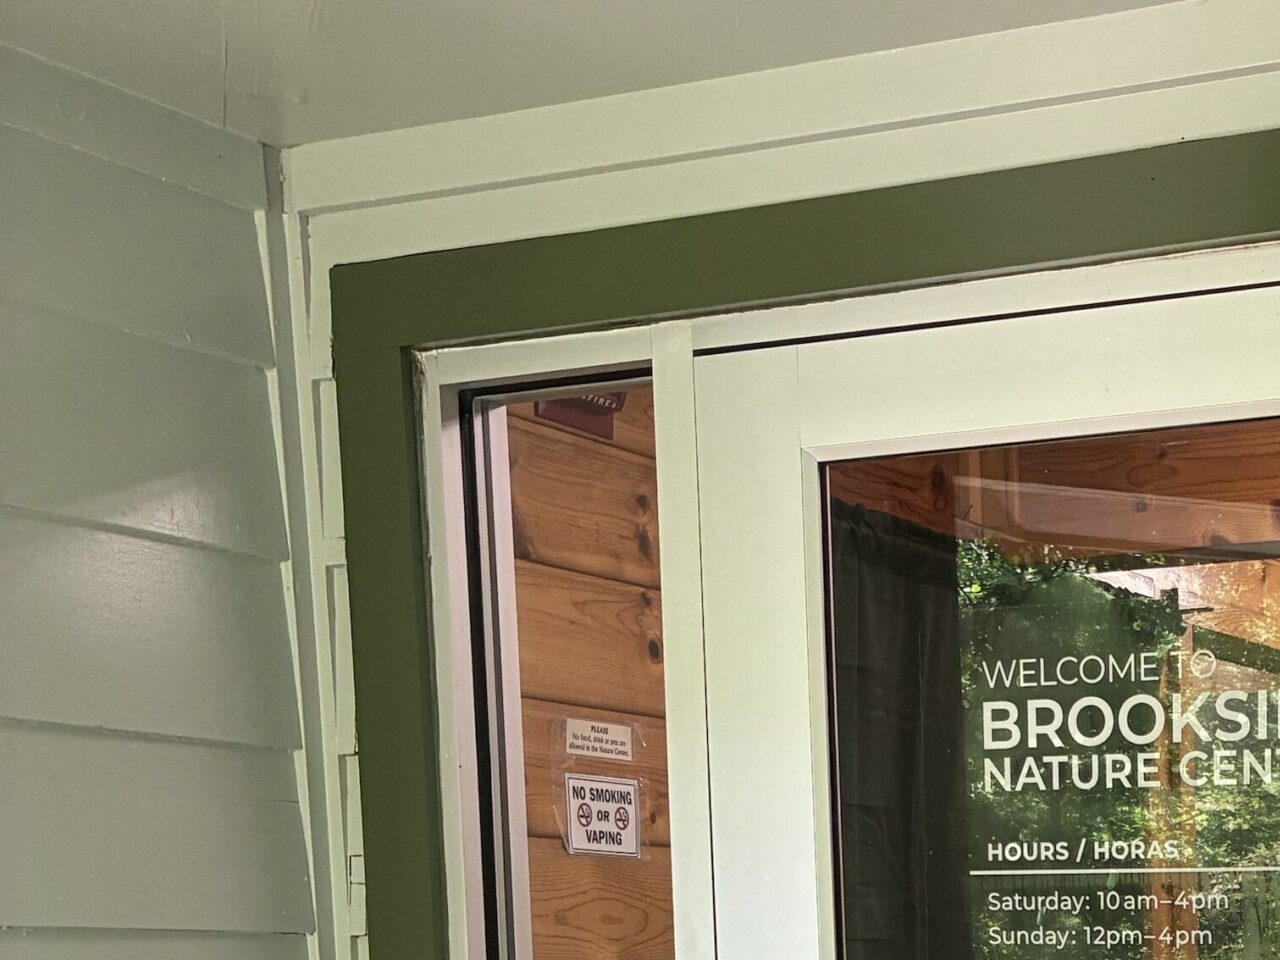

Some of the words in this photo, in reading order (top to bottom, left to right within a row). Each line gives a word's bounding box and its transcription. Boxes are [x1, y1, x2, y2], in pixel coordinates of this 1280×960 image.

[982, 652, 1159, 689] WELCOME
[1170, 649, 1217, 679] TO
[591, 725, 609, 735] PLEASE
[984, 752, 1162, 792] NATURE
[572, 786, 586, 800] NO
[589, 787, 632, 805] SMOKING
[596, 810, 610, 822] OR
[585, 830, 622, 846] VAPING
[987, 841, 1069, 862] HOURS
[1076, 838, 1087, 863] /
[1094, 840, 1179, 860] HORAS
[988, 891, 1090, 914] Saturday:
[988, 926, 1076, 950] Sunday:
